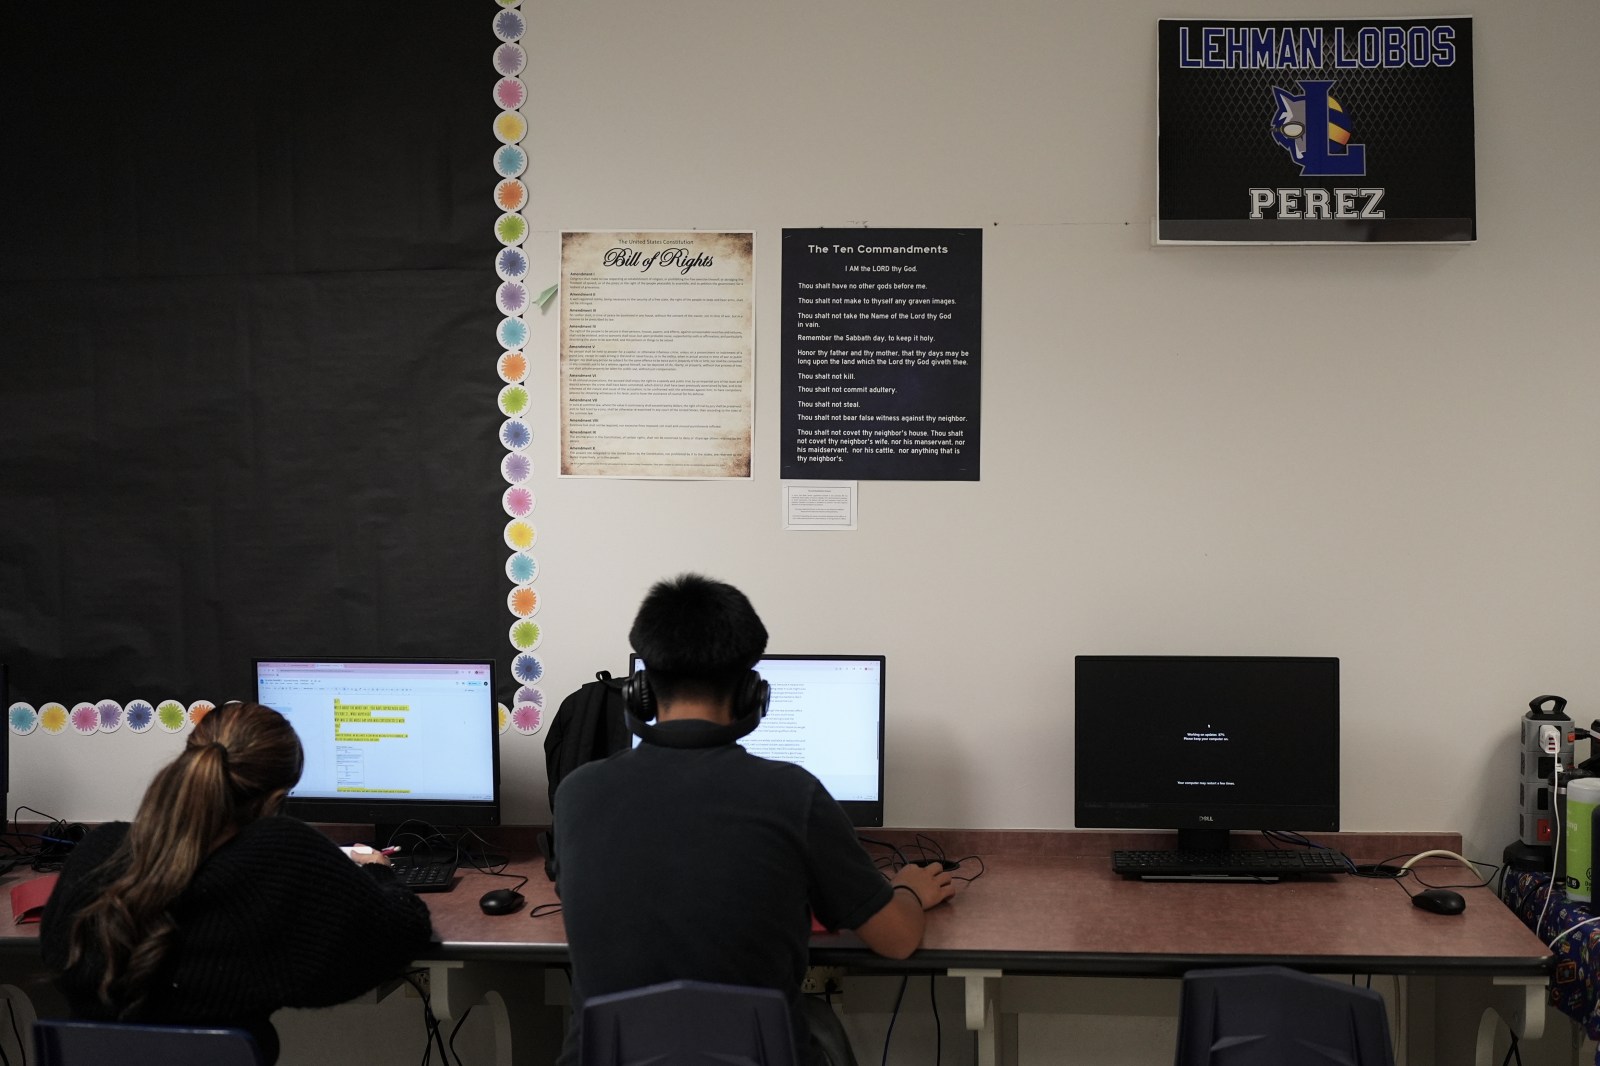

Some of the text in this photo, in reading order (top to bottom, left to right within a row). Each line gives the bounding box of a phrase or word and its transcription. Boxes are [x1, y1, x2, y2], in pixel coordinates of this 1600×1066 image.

[1179, 25, 1456, 69] LEHMAN LOBOS
[1248, 187, 1386, 220] PEREZ
[808, 245, 948, 254] The Ten Commandments
[602, 247, 714, 276] Bill of Rights
[877, 283, 892, 291] gods
[894, 282, 914, 290] before
[871, 298, 893, 306] thyself
[932, 298, 956, 306] images.
[927, 313, 937, 321] thy
[896, 335, 912, 343] keep
[920, 335, 935, 343] holy.
[864, 350, 874, 358] thy
[916, 350, 926, 358] thy
[928, 350, 943, 358] days
[945, 350, 959, 358] may
[798, 358, 811, 366] long
[813, 358, 828, 366] upon
[905, 359, 915, 367] thy
[931, 358, 951, 366] giveth
[869, 386, 897, 395] adultery.
[901, 415, 924, 423] against
[926, 415, 936, 423] thy
[938, 415, 967, 423] neighbor.
[862, 429, 873, 438] thy
[874, 429, 907, 438] neighbor's
[828, 438, 838, 446] thy
[840, 438, 873, 446] neighbor's
[911, 447, 938, 455] anything
[797, 455, 843, 463] thy neighbor's.
